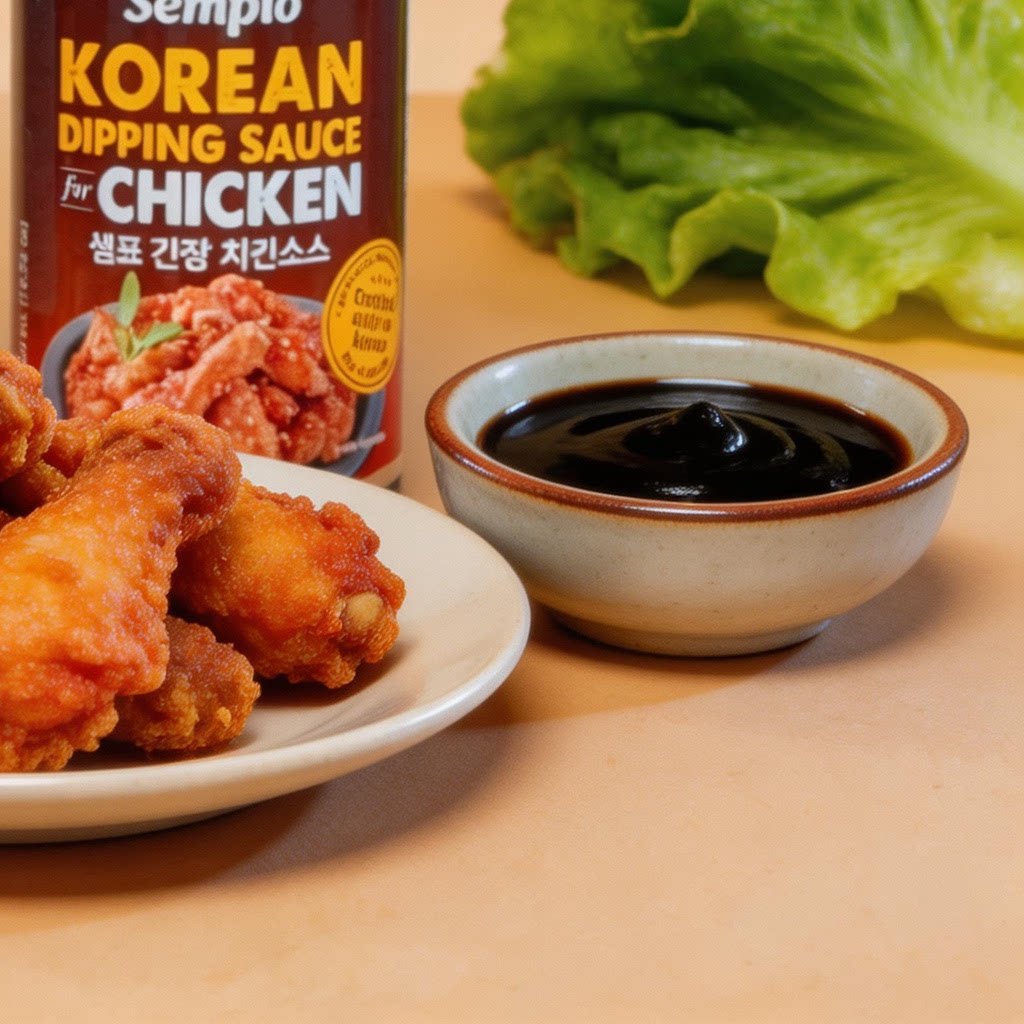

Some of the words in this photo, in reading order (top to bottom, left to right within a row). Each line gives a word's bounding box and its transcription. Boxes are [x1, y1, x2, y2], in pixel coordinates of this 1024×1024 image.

[60, 38, 363, 114] KOREAN
[58, 112, 226, 164] DIPPING
[239, 116, 362, 164] SAUCE
[60, 174, 93, 202] for
[97, 161, 362, 229] CHICKEN
